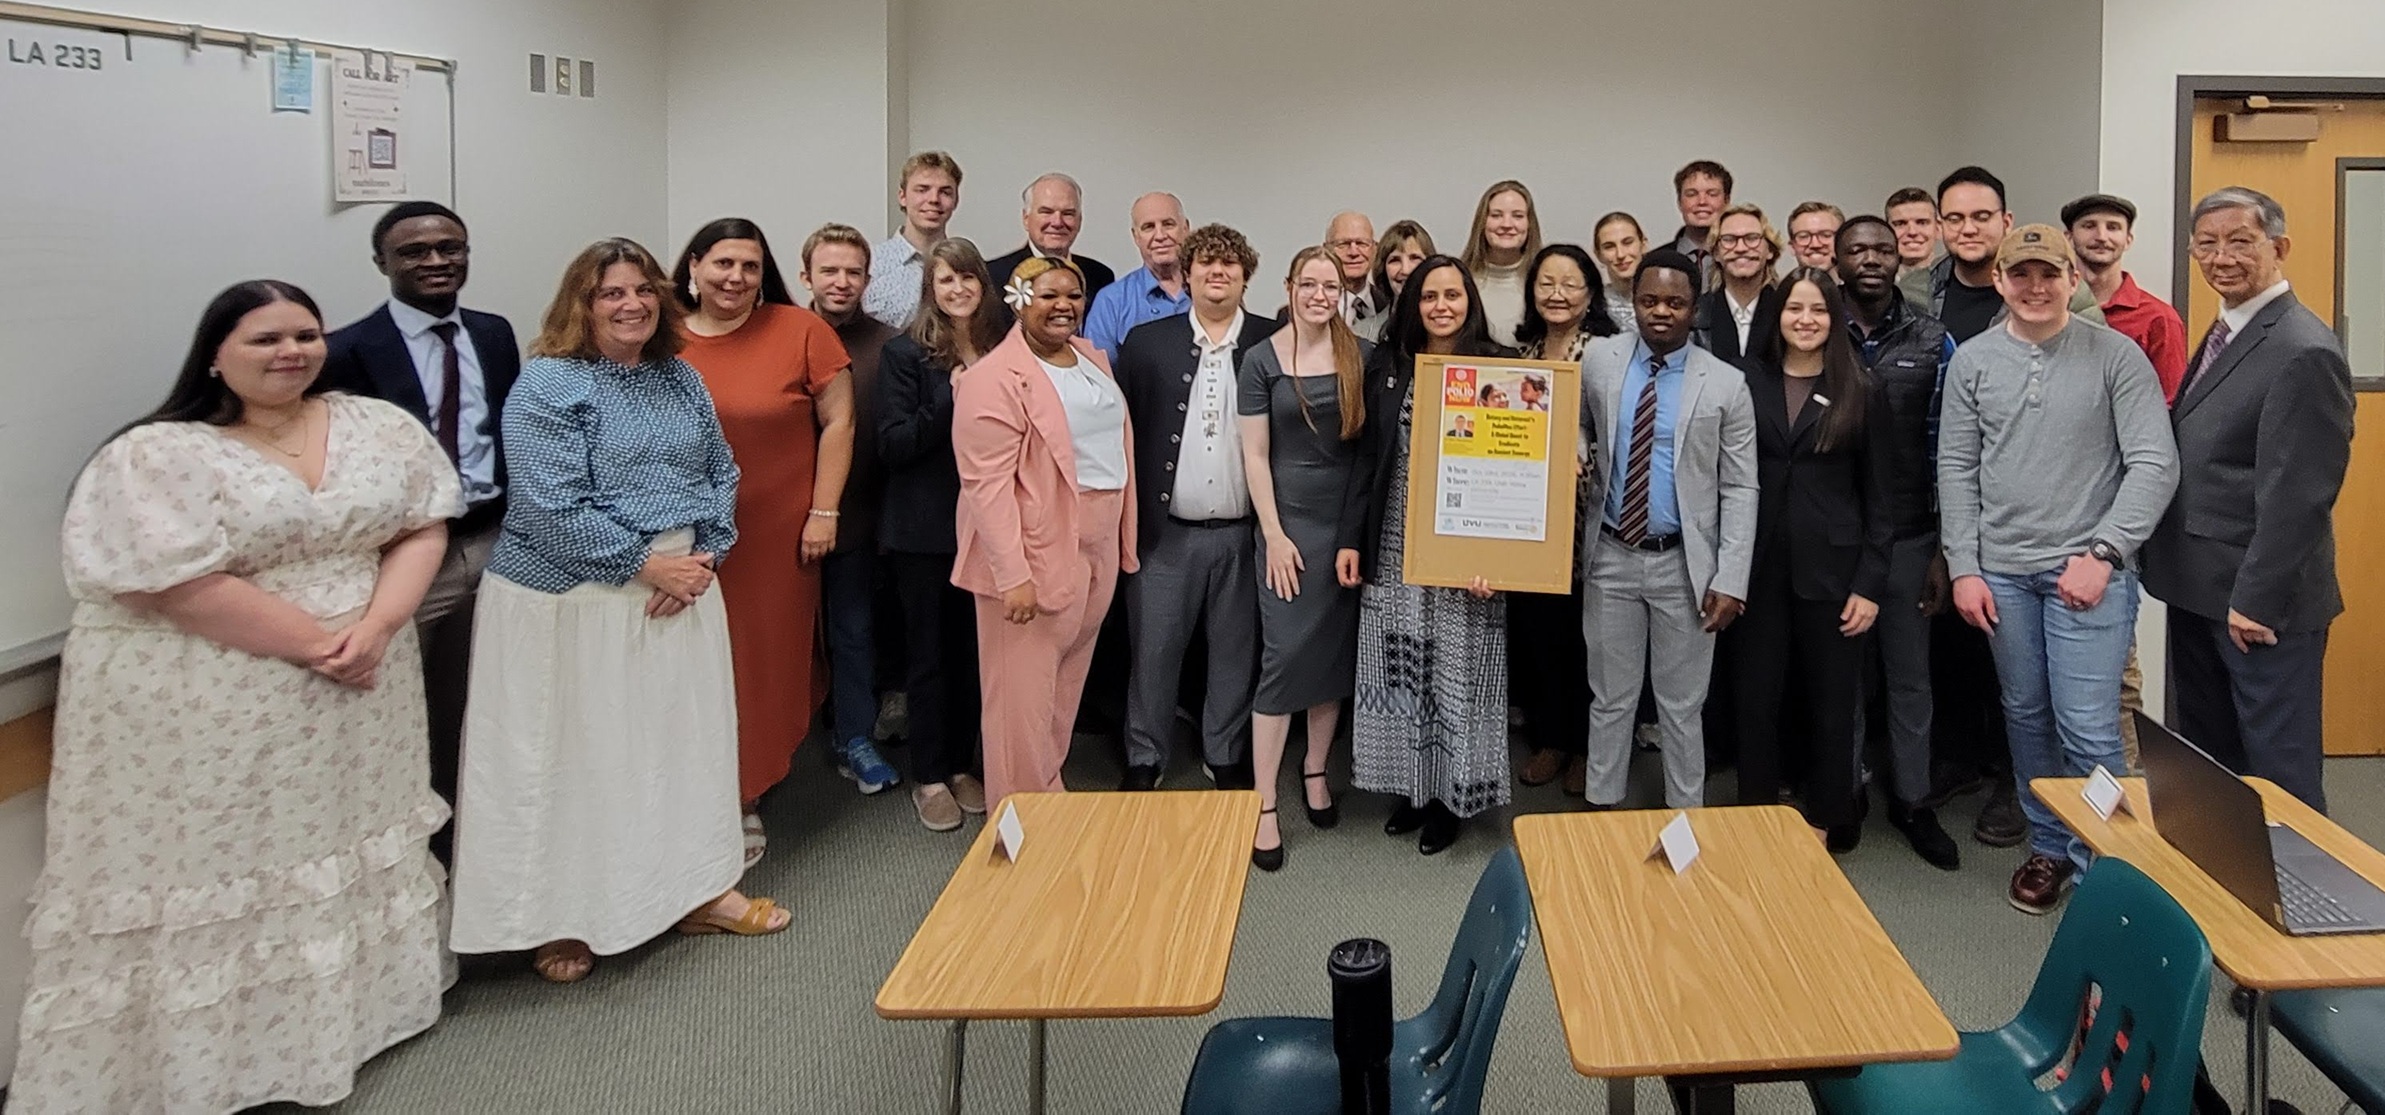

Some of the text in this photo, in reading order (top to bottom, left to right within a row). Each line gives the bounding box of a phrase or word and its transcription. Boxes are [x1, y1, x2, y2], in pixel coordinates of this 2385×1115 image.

[9, 38, 102, 70] LA 233
[343, 68, 362, 79] CALL
[1447, 386, 1474, 398] POLIO
